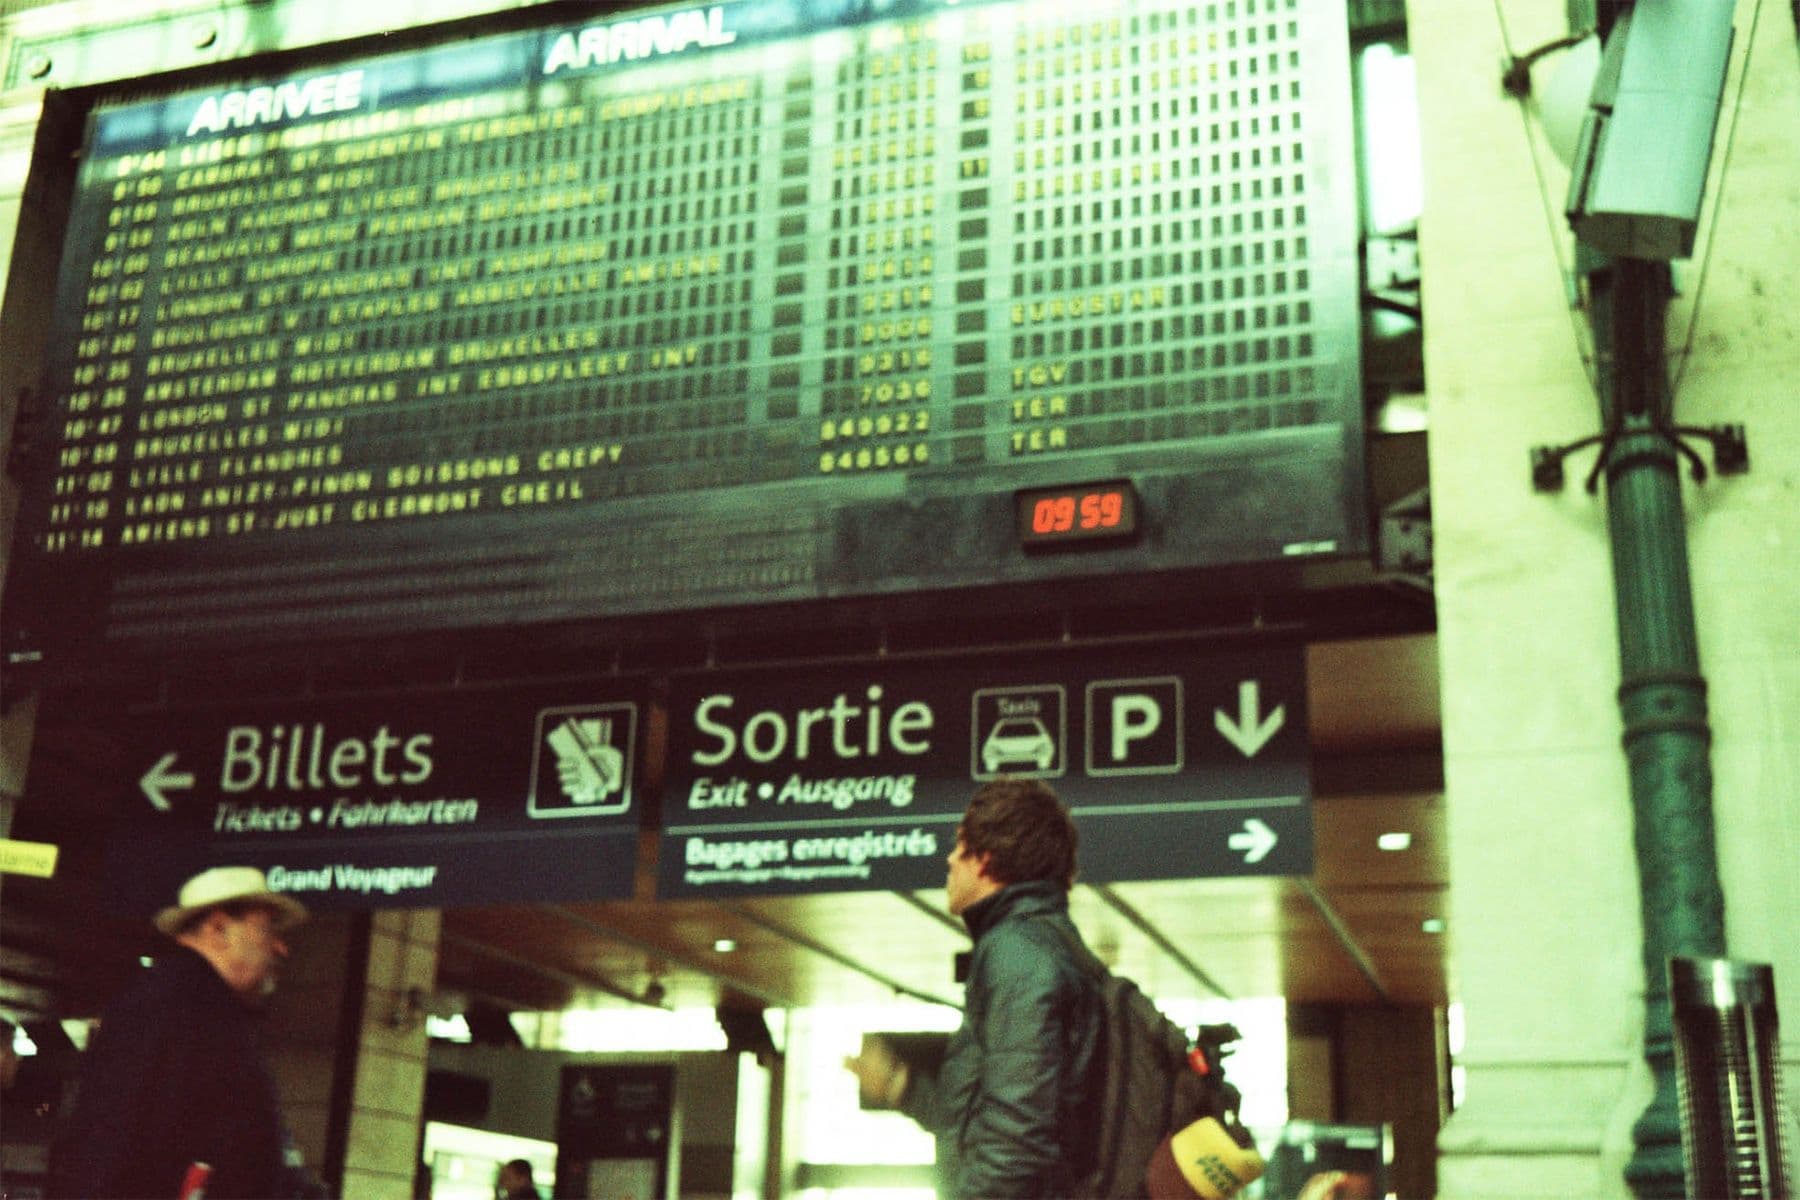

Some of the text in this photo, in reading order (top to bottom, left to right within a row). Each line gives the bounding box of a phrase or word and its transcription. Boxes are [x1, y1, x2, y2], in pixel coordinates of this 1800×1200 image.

[542, 7, 738, 75] ARRIVAL
[187, 70, 365, 138] ARRIVEE
[219, 723, 435, 793] Billets
[692, 685, 934, 766] Sortie
[1111, 694, 1162, 761] P
[213, 798, 479, 832] Tickets Fahrkarten
[688, 773, 917, 810] Exit Ausgang
[266, 864, 438, 895] Grand Voyageur
[685, 828, 938, 870] Bagages enregistrés
